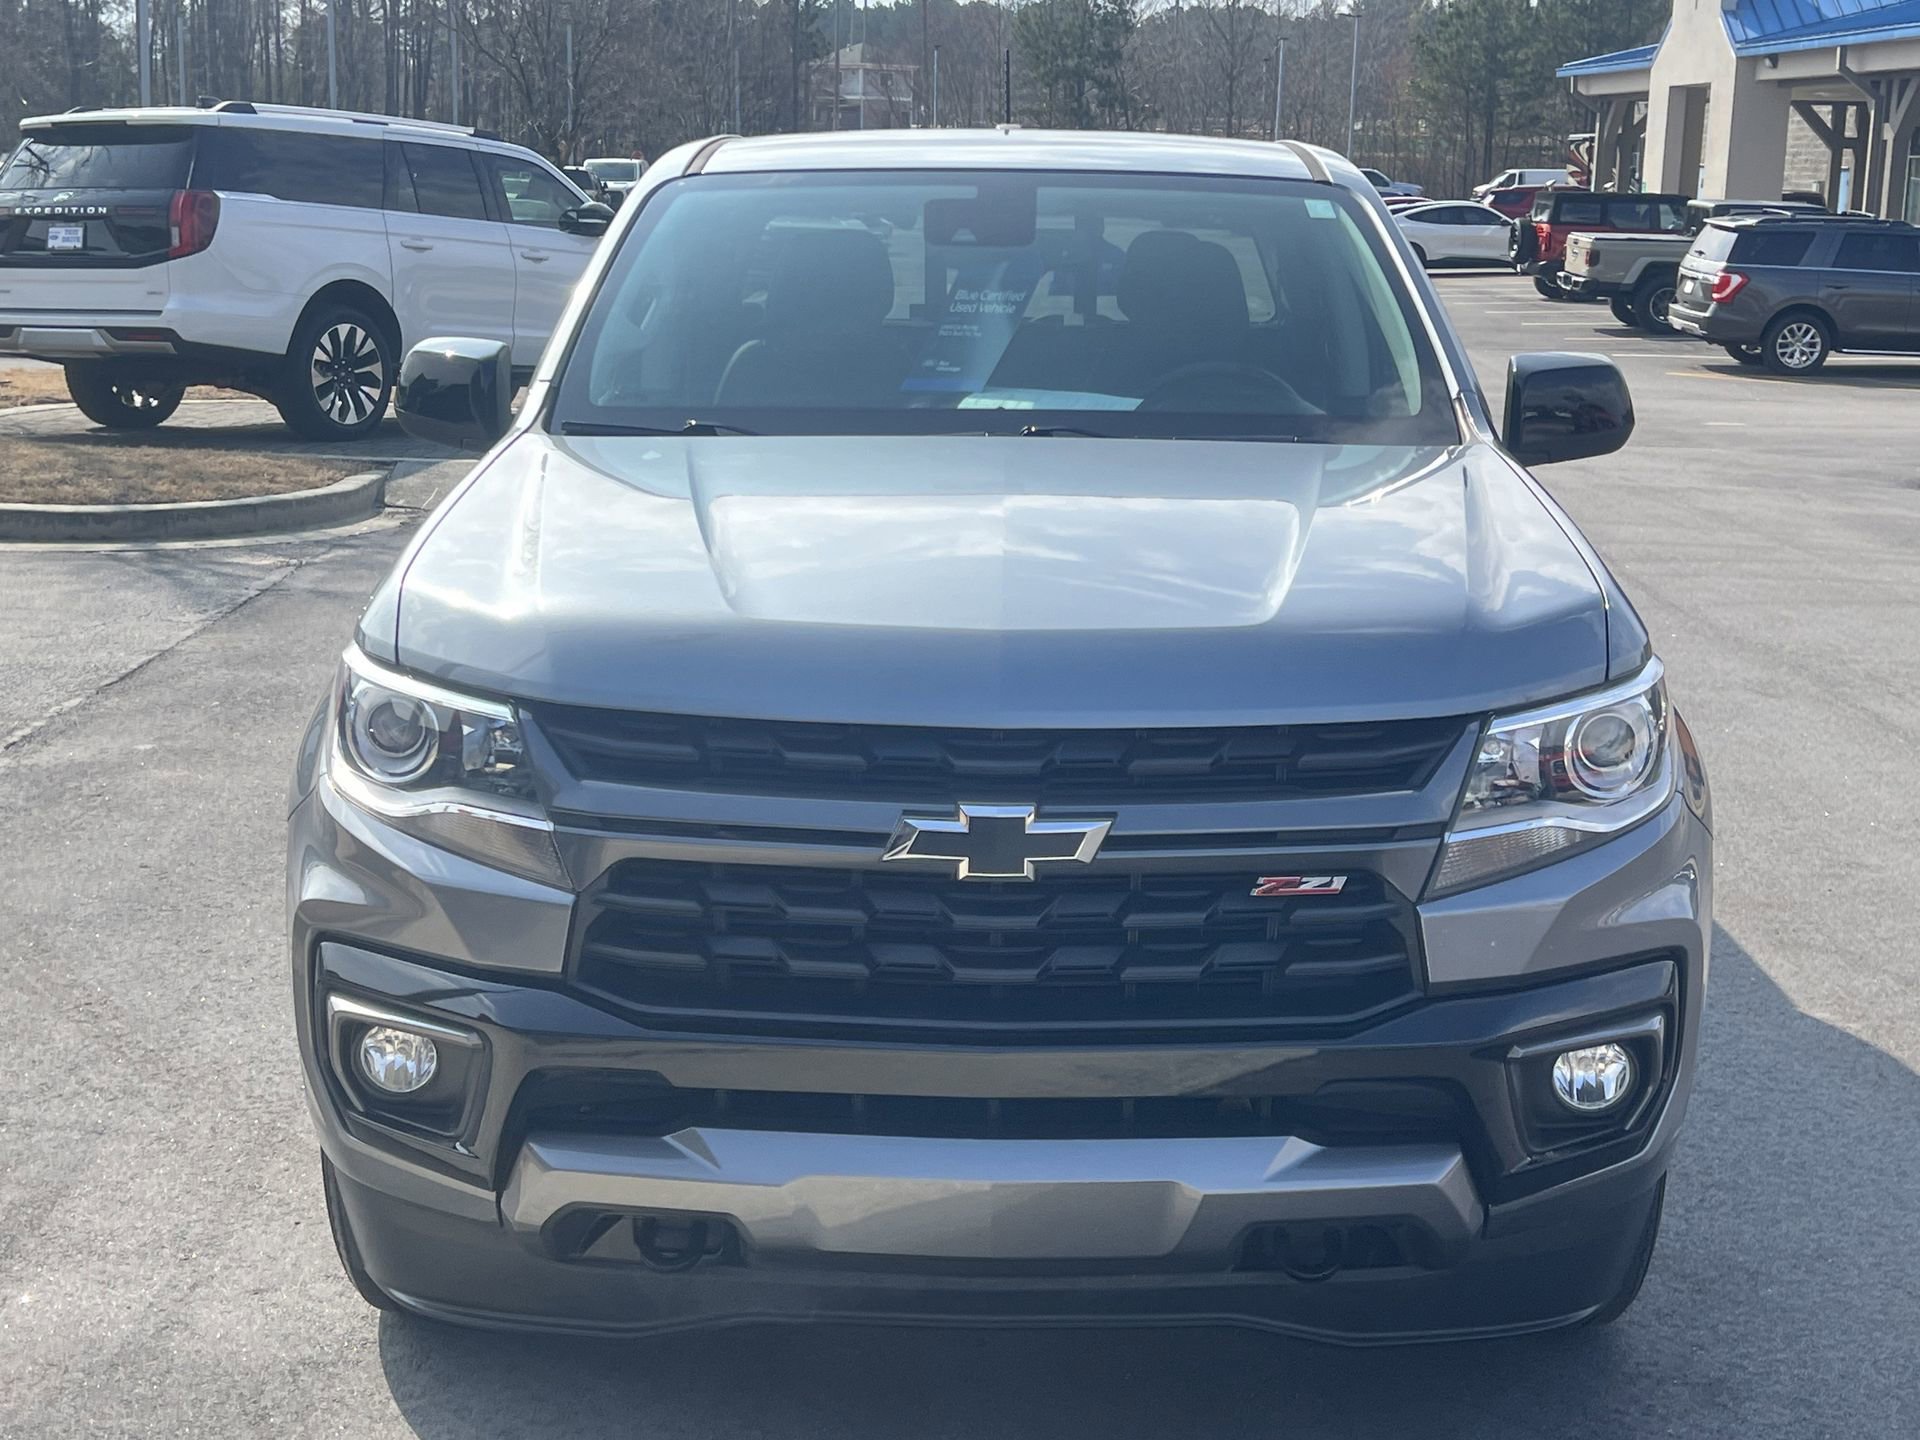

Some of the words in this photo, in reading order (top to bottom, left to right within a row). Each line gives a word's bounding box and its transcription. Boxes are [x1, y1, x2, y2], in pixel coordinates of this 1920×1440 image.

[14, 206, 108, 215] EXPEDITION
[949, 301, 978, 313] Used
[979, 301, 1016, 313] Vehicle
[1249, 875, 1348, 896] Z71
